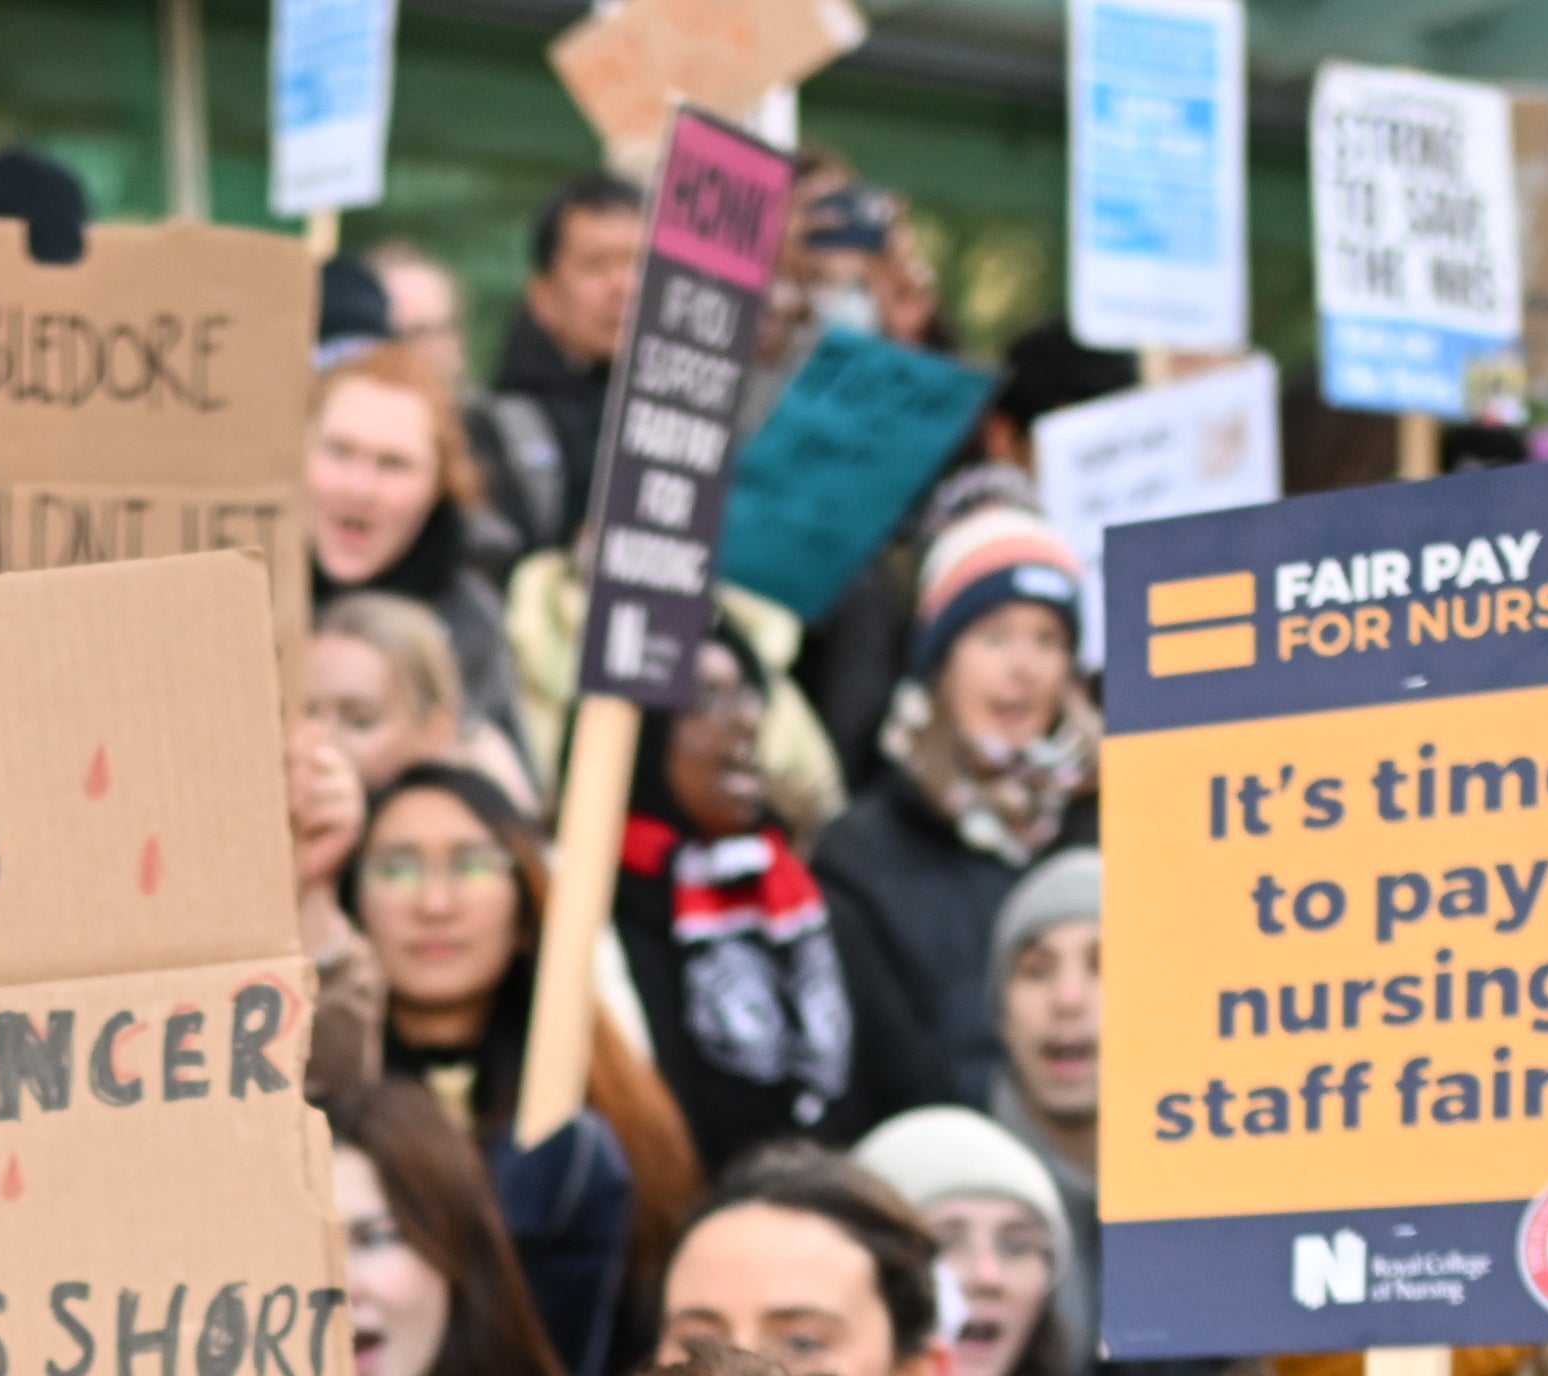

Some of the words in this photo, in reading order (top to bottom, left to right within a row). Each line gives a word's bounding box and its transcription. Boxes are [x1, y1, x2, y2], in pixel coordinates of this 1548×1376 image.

[1274, 550, 1413, 612] FAIR
[1421, 530, 1544, 596] PAY
[1276, 604, 1391, 662] FOR
[1208, 762, 1346, 841] It's
[1249, 872, 1347, 937] to
[1154, 1061, 1373, 1143] staff
